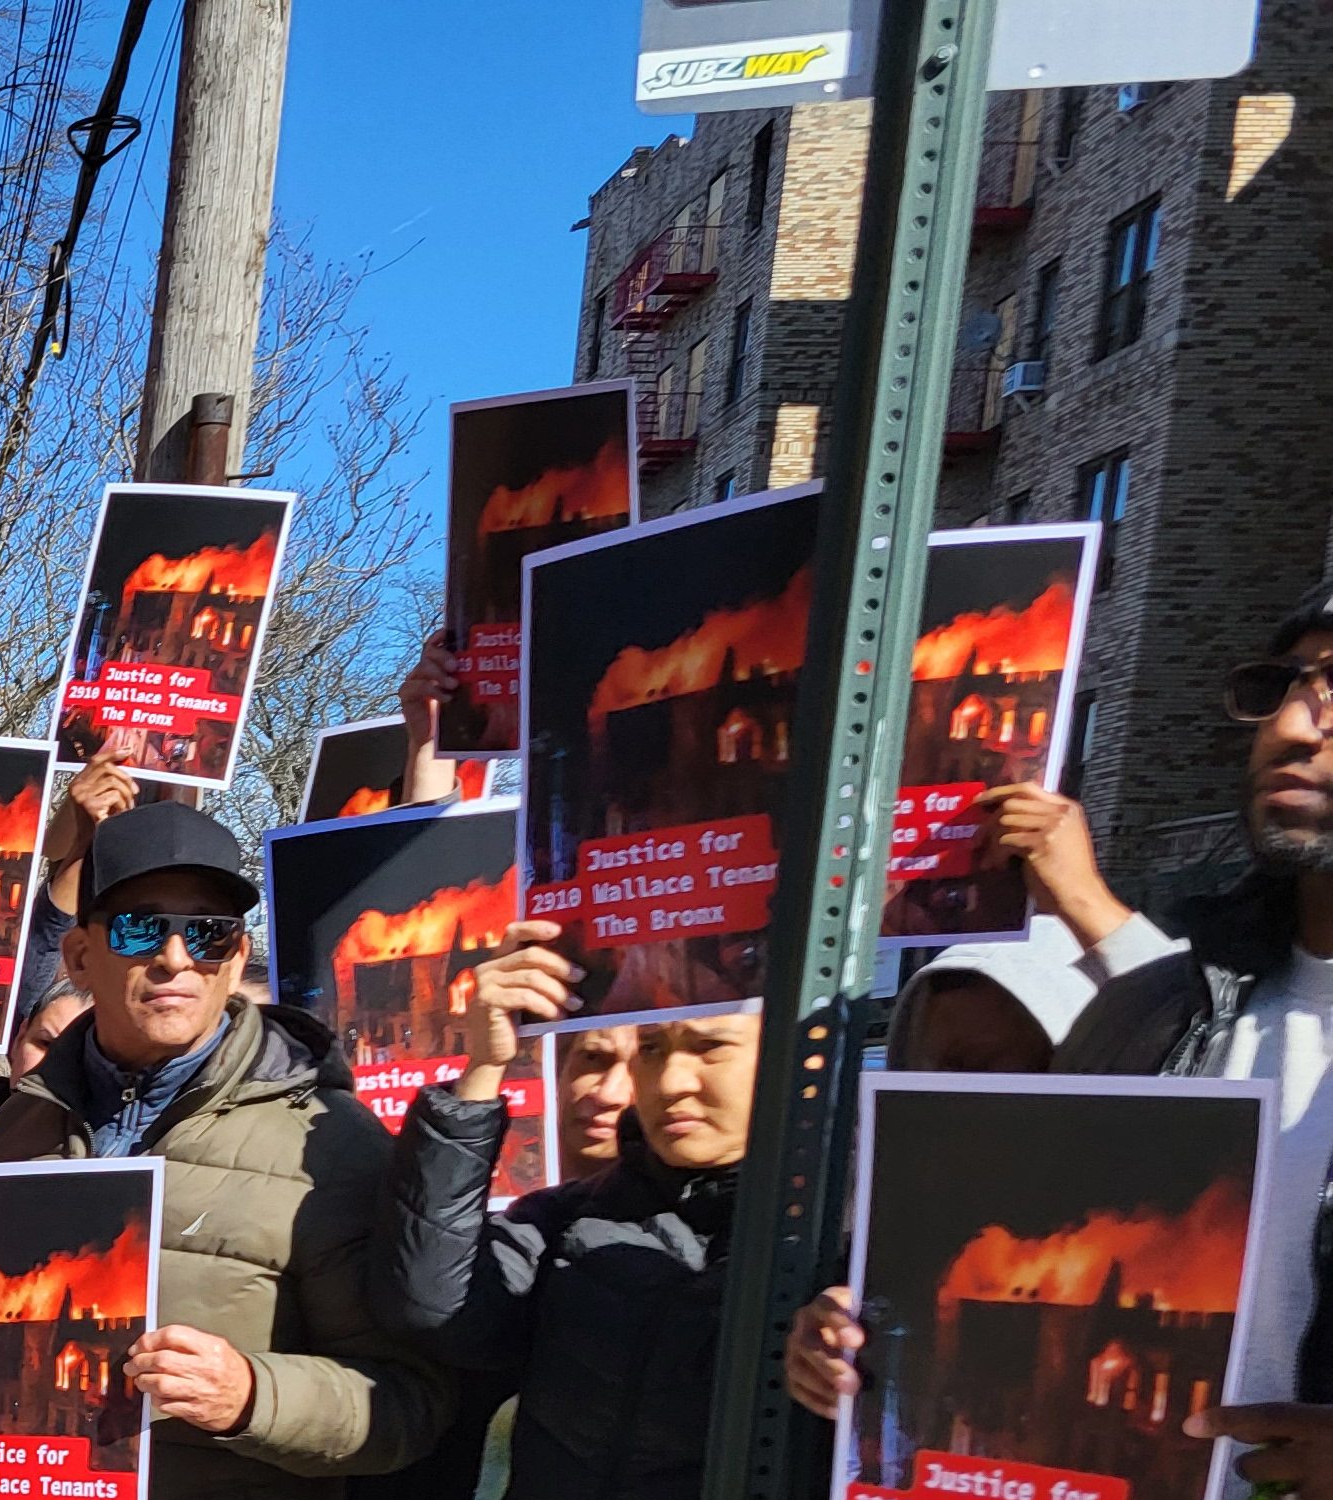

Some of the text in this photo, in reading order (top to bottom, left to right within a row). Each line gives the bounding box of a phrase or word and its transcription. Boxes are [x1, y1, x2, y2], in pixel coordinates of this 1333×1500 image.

[106, 668, 195, 688] Justice for
[69, 686, 227, 712] 2910 Wallace Tenants
[102, 706, 174, 726] The Bronx
[587, 830, 743, 872] Justice for
[531, 887, 582, 914] 2910
[592, 874, 694, 904] Wallace
[592, 905, 725, 938] The Bronx
[355, 1066, 425, 1091] ustice
[37, 1444, 69, 1466] for
[40, 1476, 118, 1498] Tenants
